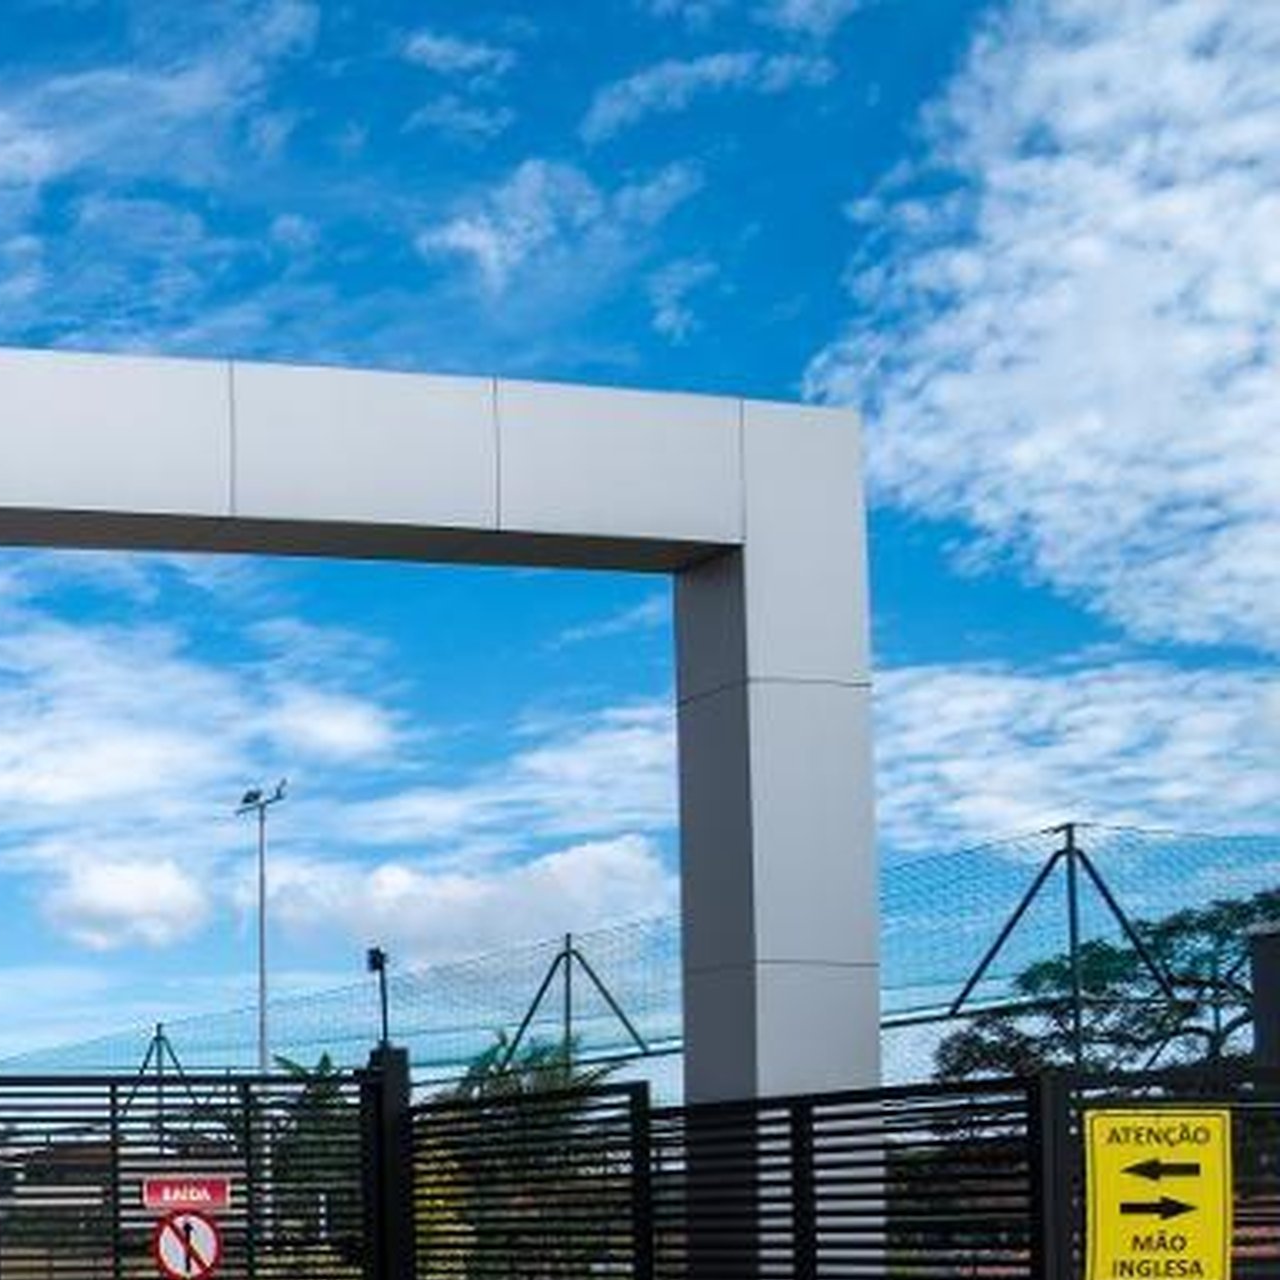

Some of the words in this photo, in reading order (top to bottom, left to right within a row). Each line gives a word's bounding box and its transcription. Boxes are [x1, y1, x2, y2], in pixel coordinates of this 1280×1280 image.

[1106, 1122, 1212, 1148] ATENÇÃO
[1131, 1229, 1188, 1252] MÃO
[1113, 1259, 1205, 1279] INGLESA
